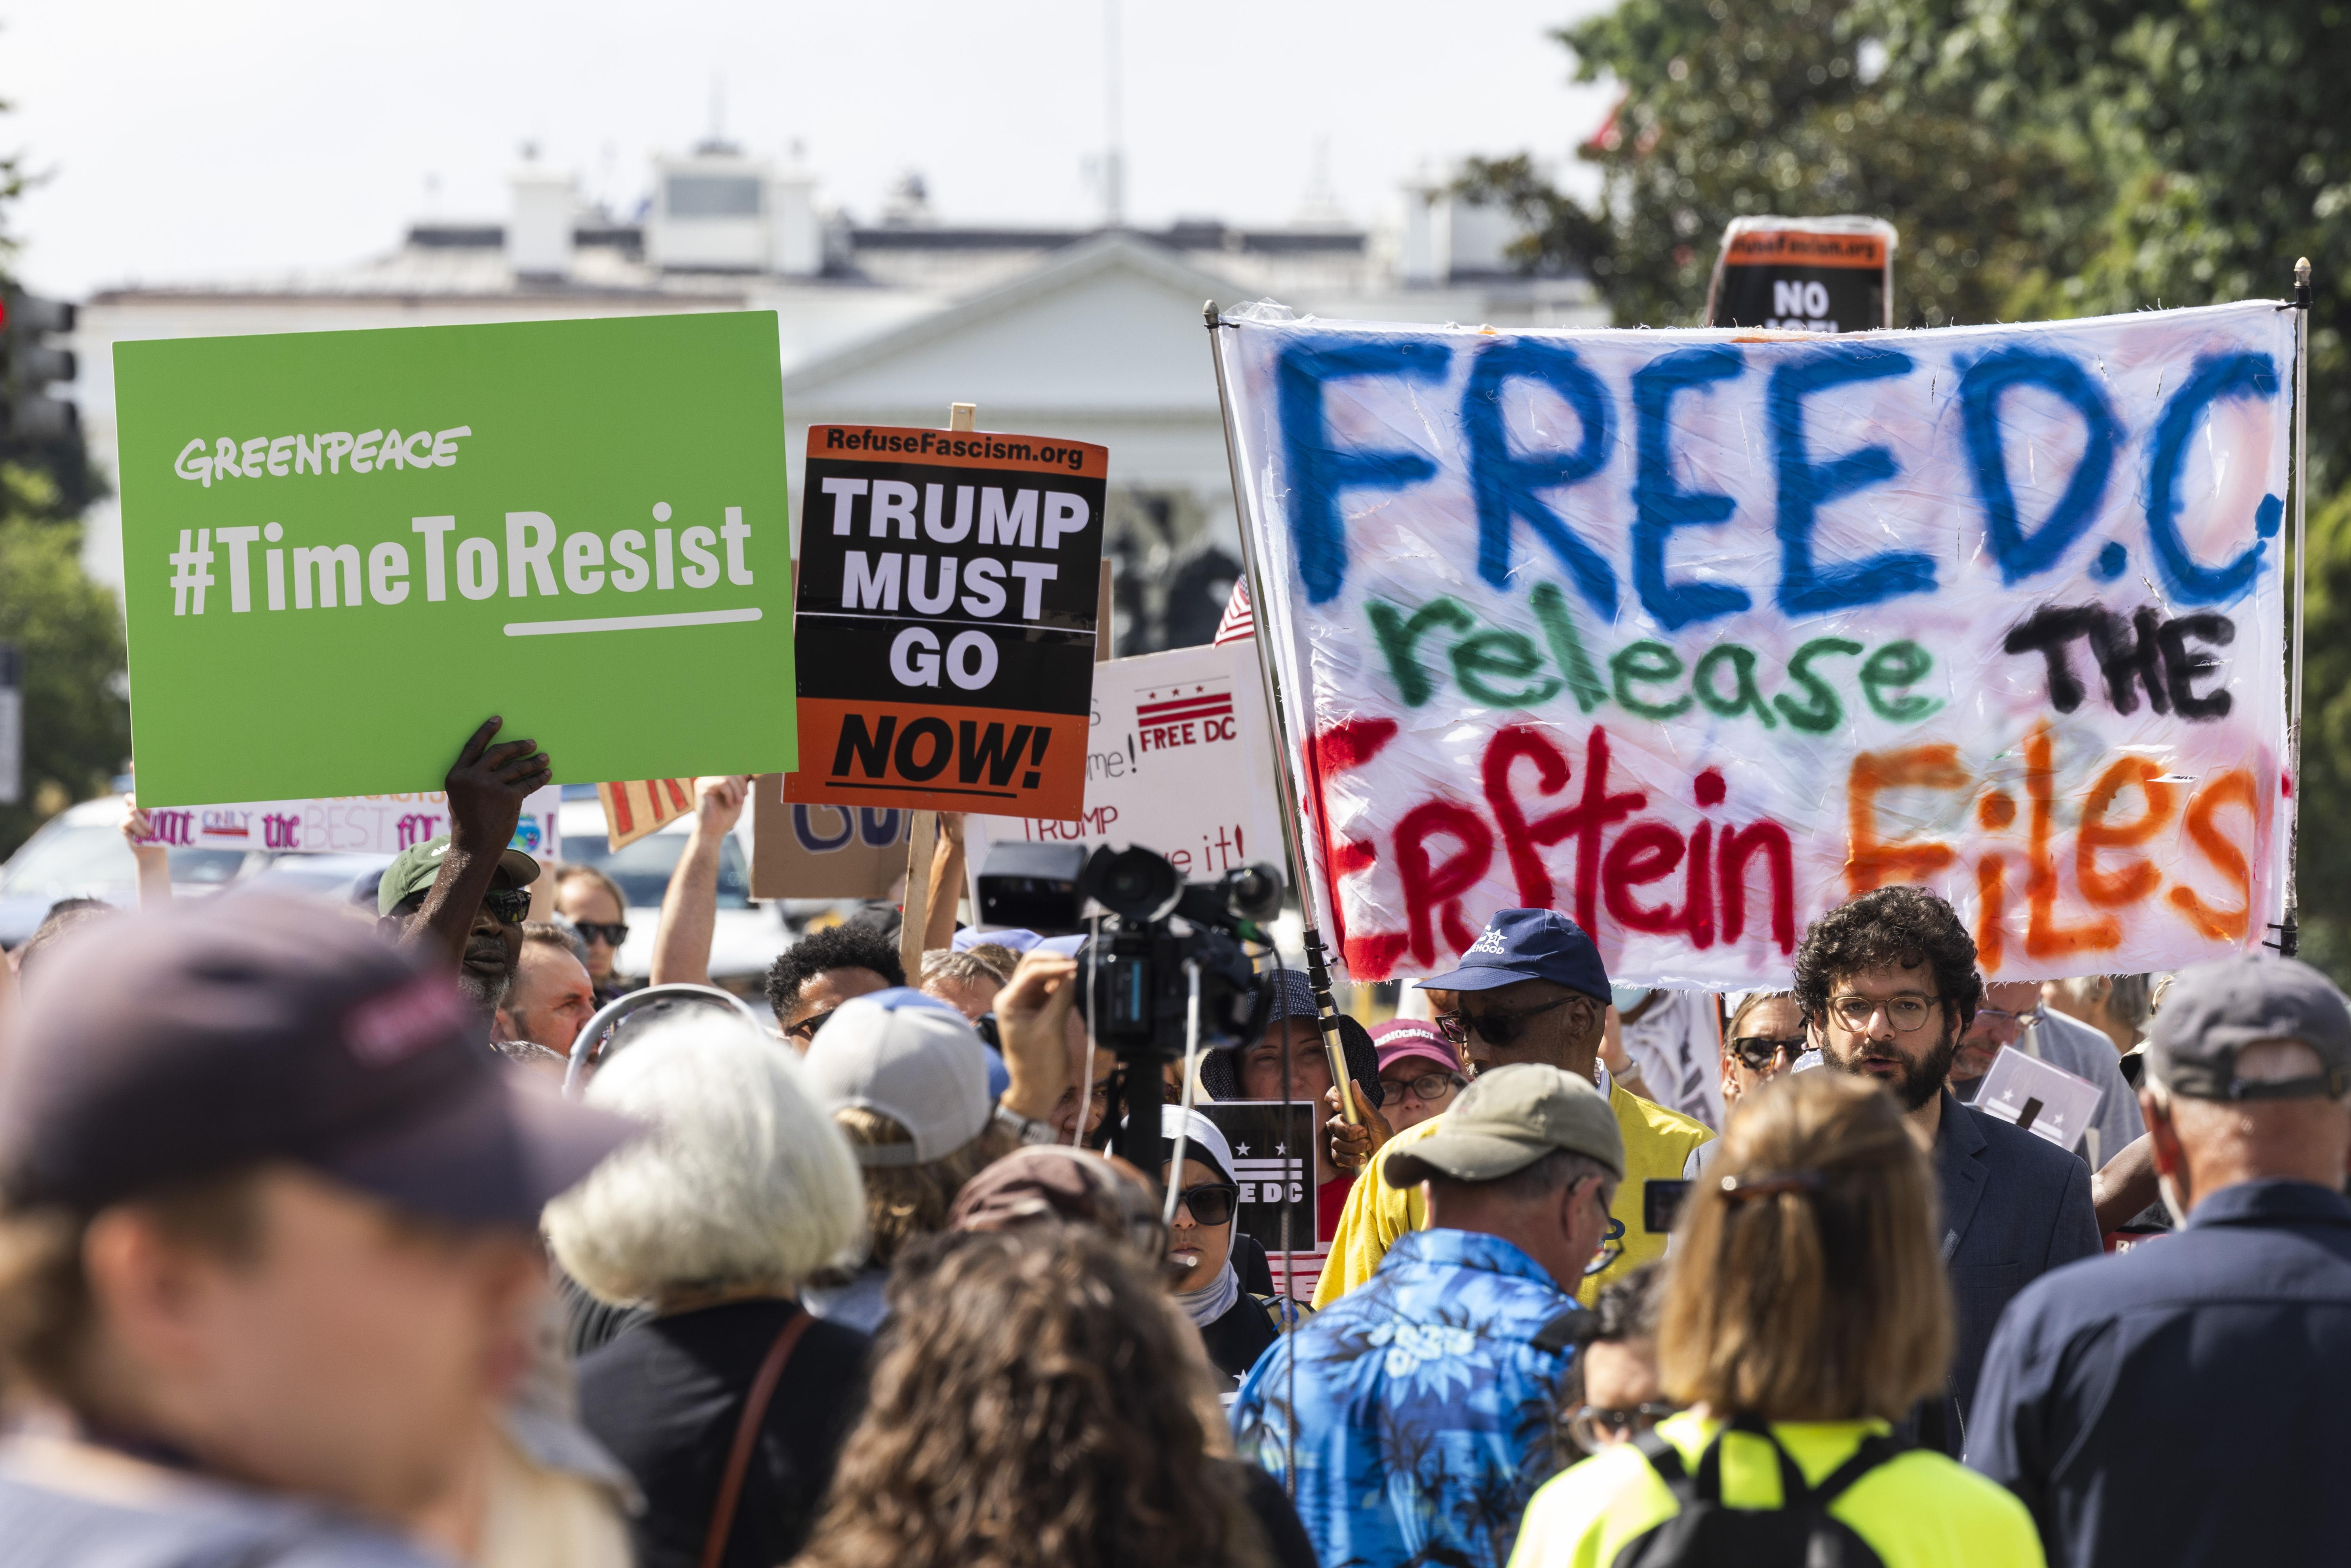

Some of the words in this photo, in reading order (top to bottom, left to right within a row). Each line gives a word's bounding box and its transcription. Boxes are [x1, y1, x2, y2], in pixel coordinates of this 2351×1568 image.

[1773, 280, 1830, 318] NO
[174, 425, 472, 487] GREENPEACE
[826, 428, 1084, 471] RefuseFascism.org
[822, 477, 1090, 549] TRUMP
[1277, 339, 1939, 633] FREE
[1951, 347, 2284, 607] D.C.
[169, 502, 754, 616] #TimeToResist
[842, 551, 1058, 621] MUST
[889, 627, 999, 690] GO
[1366, 581, 1947, 734] release
[2004, 601, 2237, 722] THE
[831, 713, 1052, 789] NOW!
[1087, 733, 1137, 781] me!
[1139, 723, 1196, 752] FREE
[1204, 717, 1237, 743] DC
[262, 812, 300, 848] the
[304, 805, 392, 850] BEST
[396, 813, 441, 851] for
[1203, 824, 1244, 872] it!
[1374, 1028, 1434, 1047] DEMOCRACY
[1263, 1182, 1303, 1203] DC
